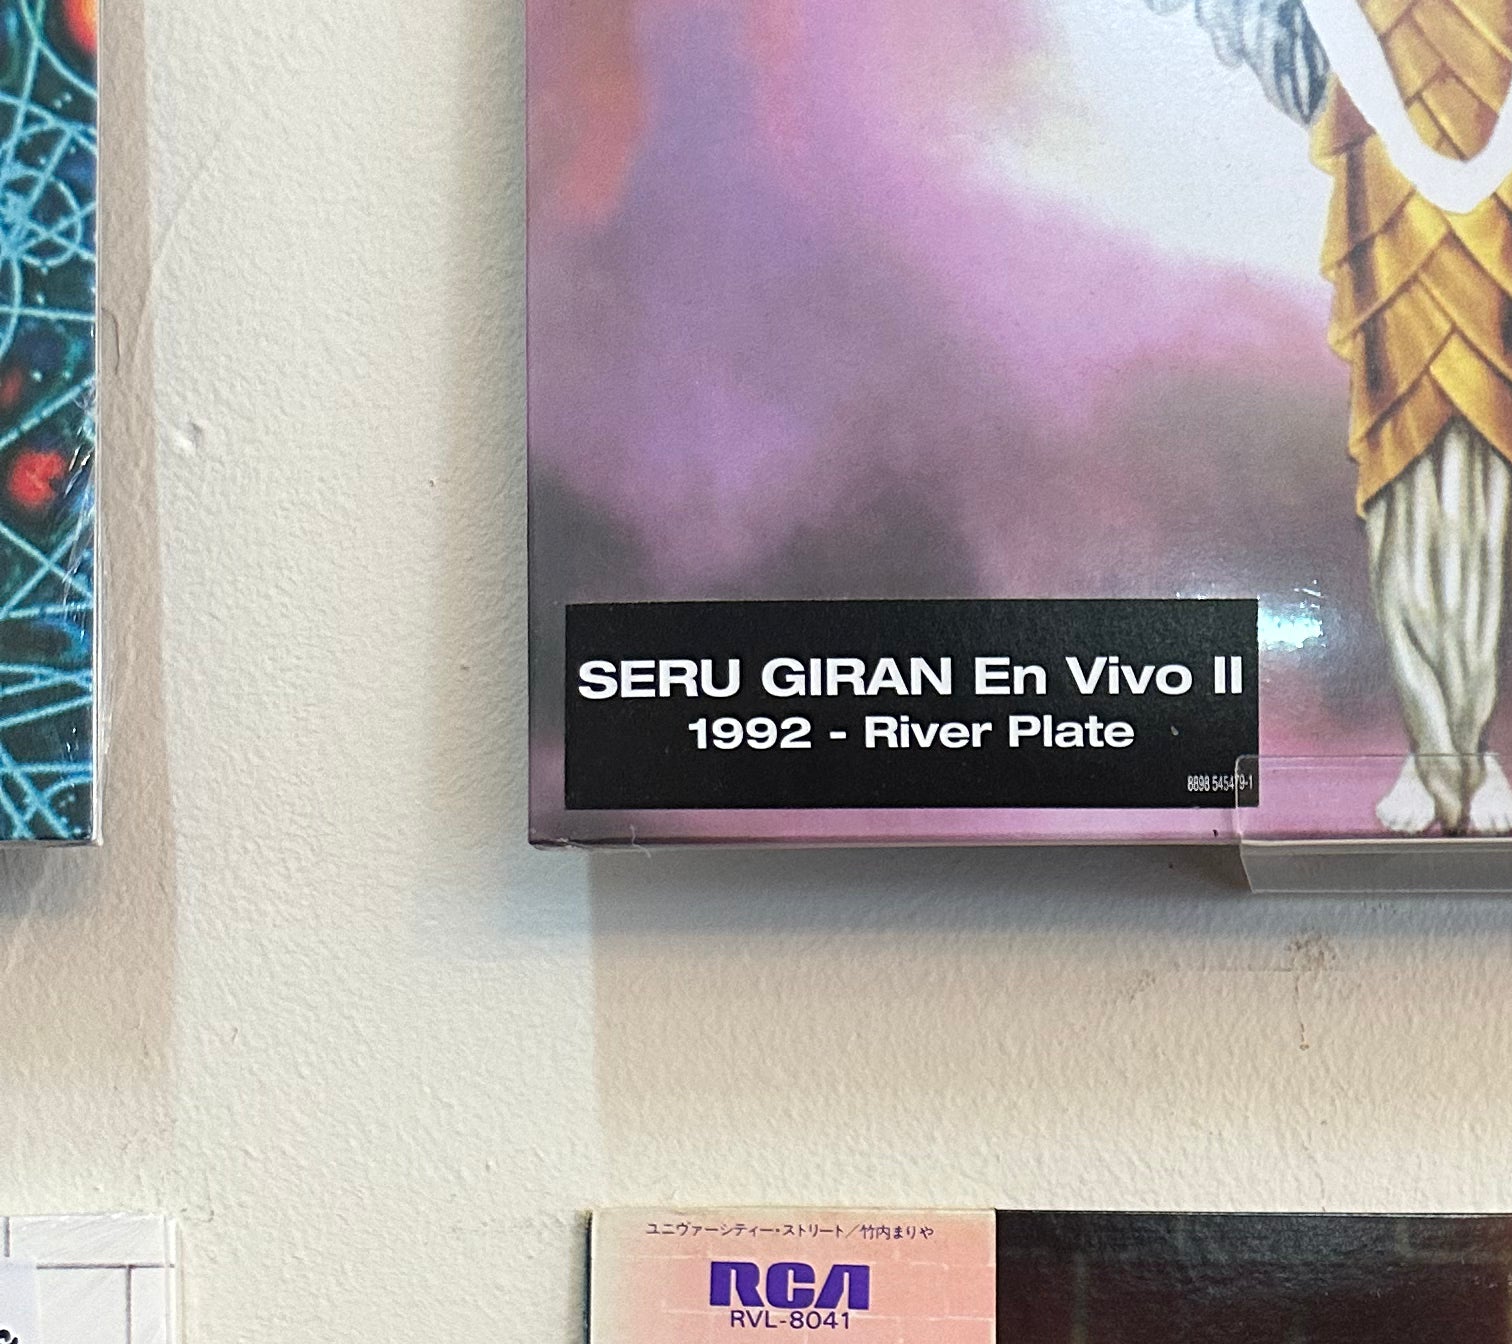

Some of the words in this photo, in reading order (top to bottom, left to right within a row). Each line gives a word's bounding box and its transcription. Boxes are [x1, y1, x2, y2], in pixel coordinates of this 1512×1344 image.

[577, 657, 741, 700] SERU
[761, 656, 952, 698] GIRAN
[976, 657, 1047, 696] En
[1065, 655, 1193, 696] Vivo
[1214, 656, 1244, 695] II
[688, 717, 812, 750] 1992
[831, 732, 847, 740] -
[865, 714, 992, 749] River
[1009, 714, 1135, 749] Plate
[710, 1261, 870, 1311] RCA
[730, 1310, 851, 1330] RVL-8041
